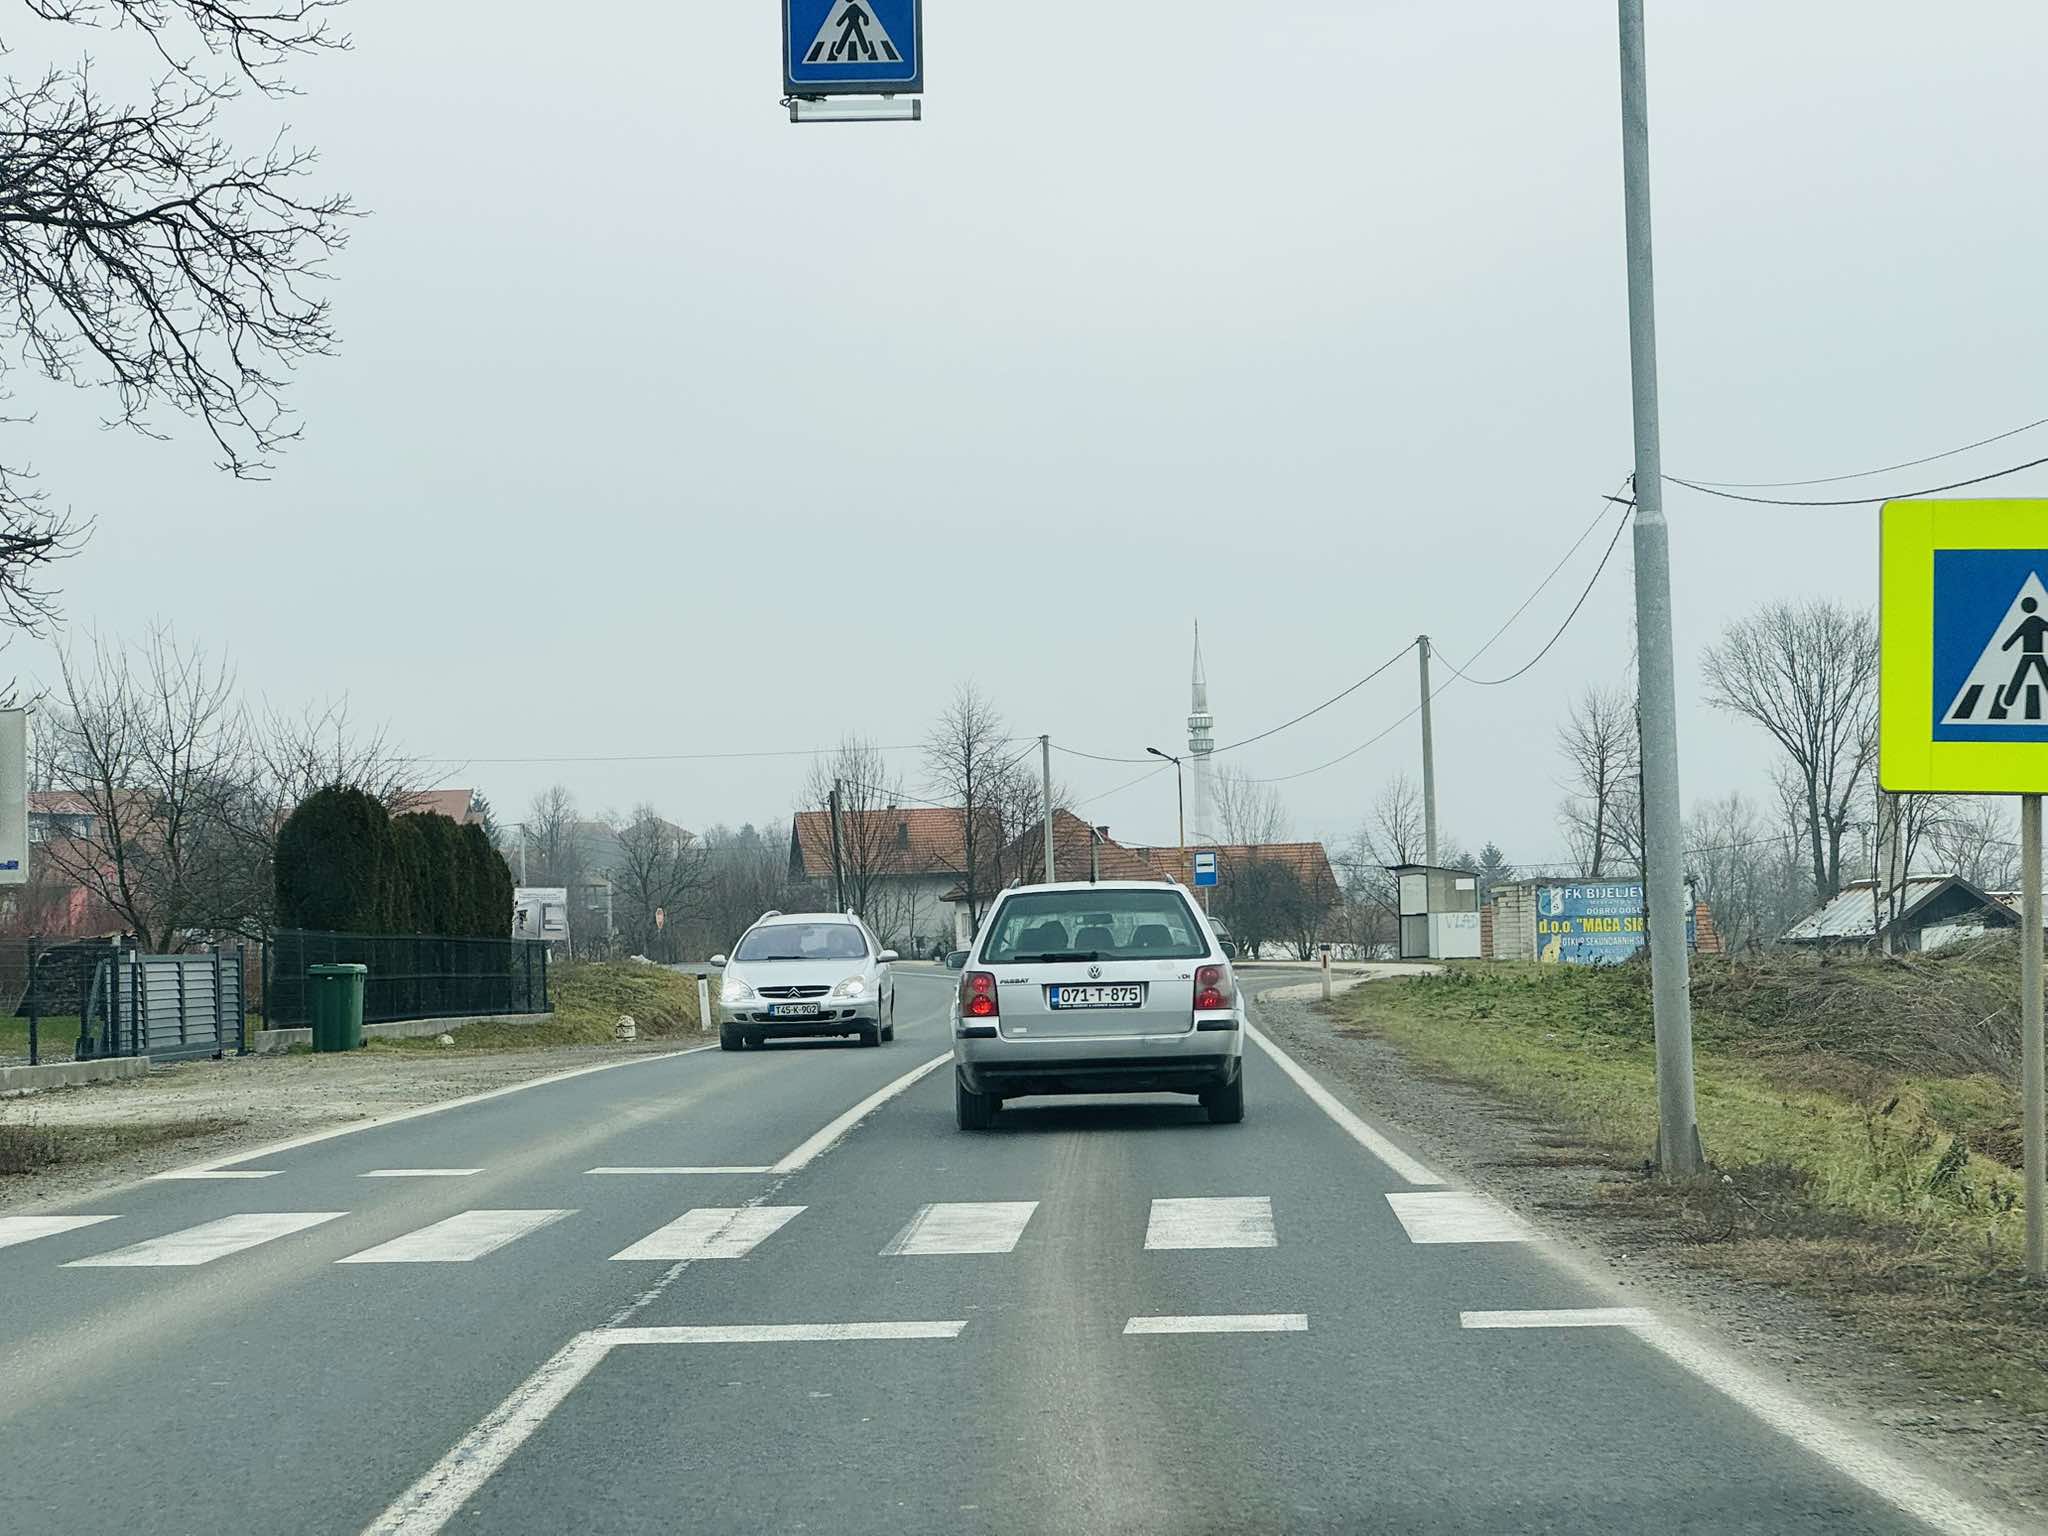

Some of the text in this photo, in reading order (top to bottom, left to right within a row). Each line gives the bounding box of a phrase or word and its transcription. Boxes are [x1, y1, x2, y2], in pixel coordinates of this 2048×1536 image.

[1564, 888, 1582, 899] FK
[1586, 907, 1617, 915] DOBRO
[1624, 917, 1644, 932] SIR
[1061, 987, 1138, 1002] 071-T-875
[775, 1005, 817, 1015] T45-K-902
